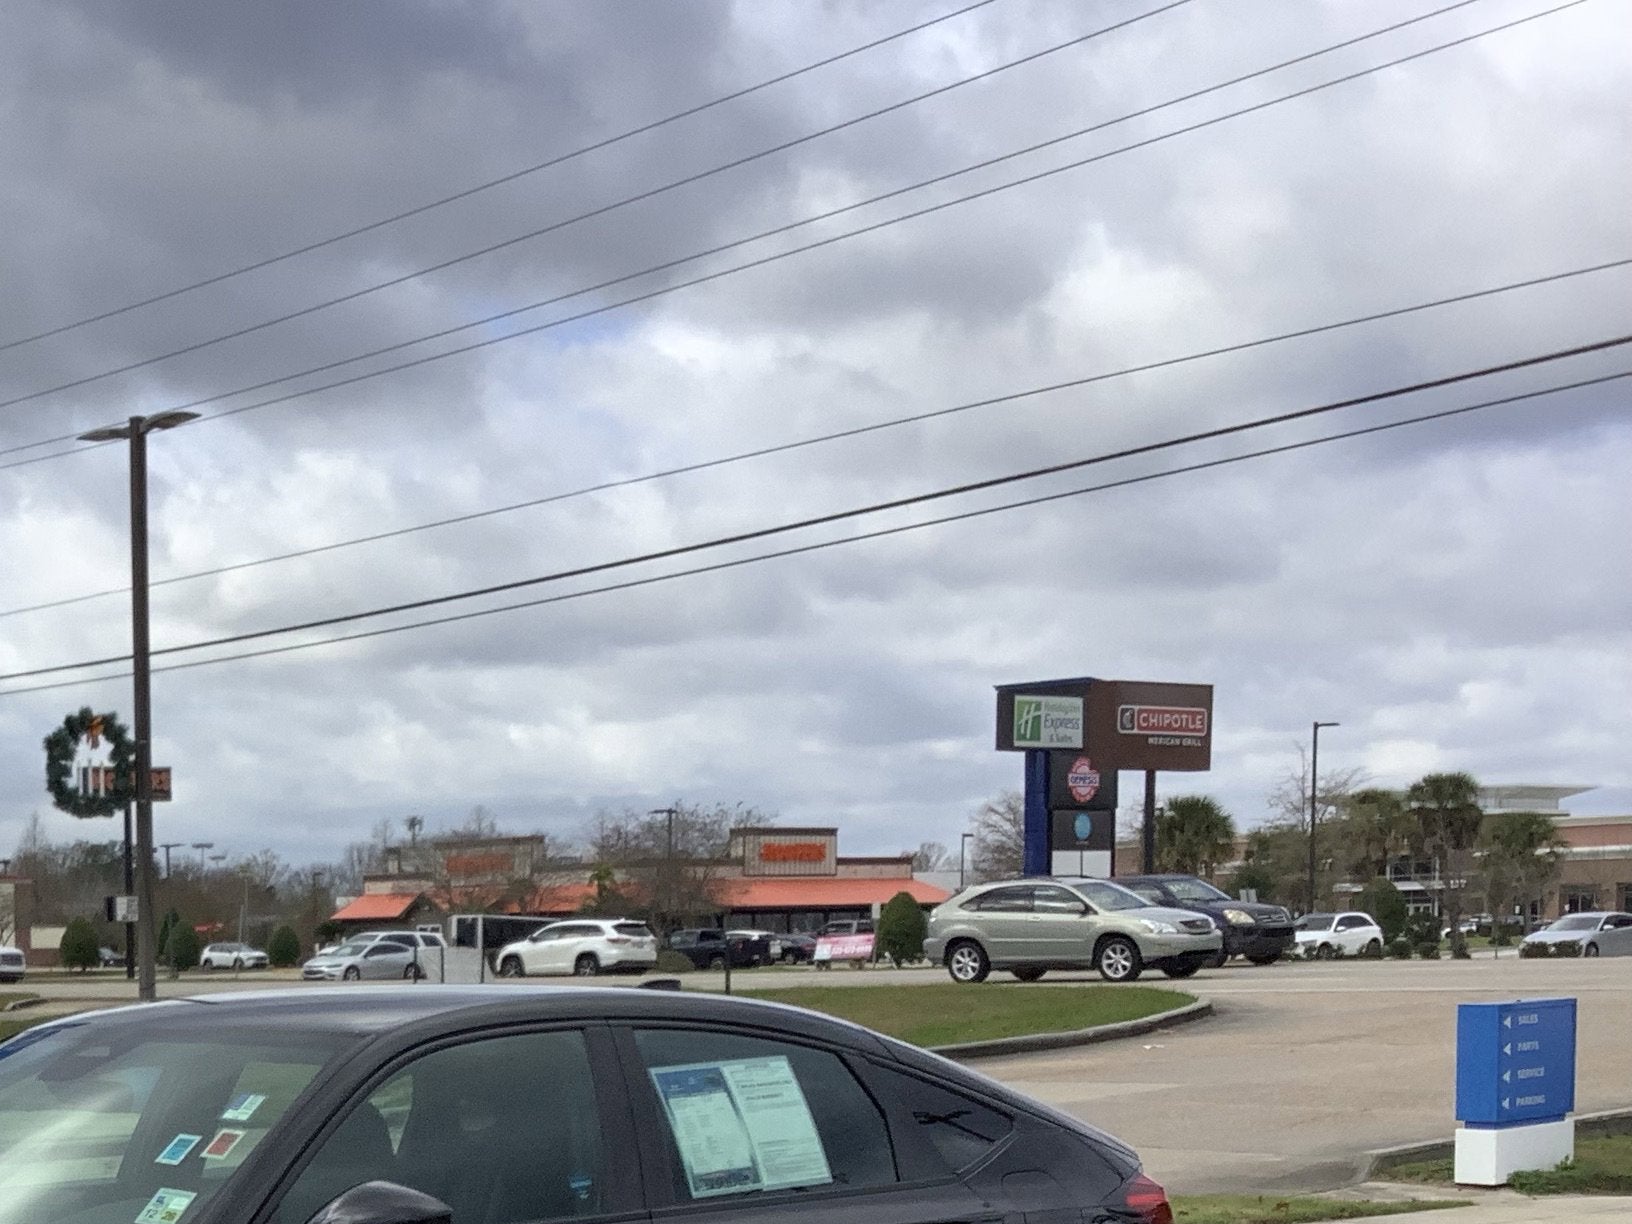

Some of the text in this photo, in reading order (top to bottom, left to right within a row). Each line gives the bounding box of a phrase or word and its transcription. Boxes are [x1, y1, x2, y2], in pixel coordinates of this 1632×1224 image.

[1043, 713, 1080, 731] Express
[1139, 712, 1204, 729] CHIPOTLE
[1148, 737, 1202, 747] MEXICAN GRILL
[1515, 1094, 1546, 1107] PARKING
